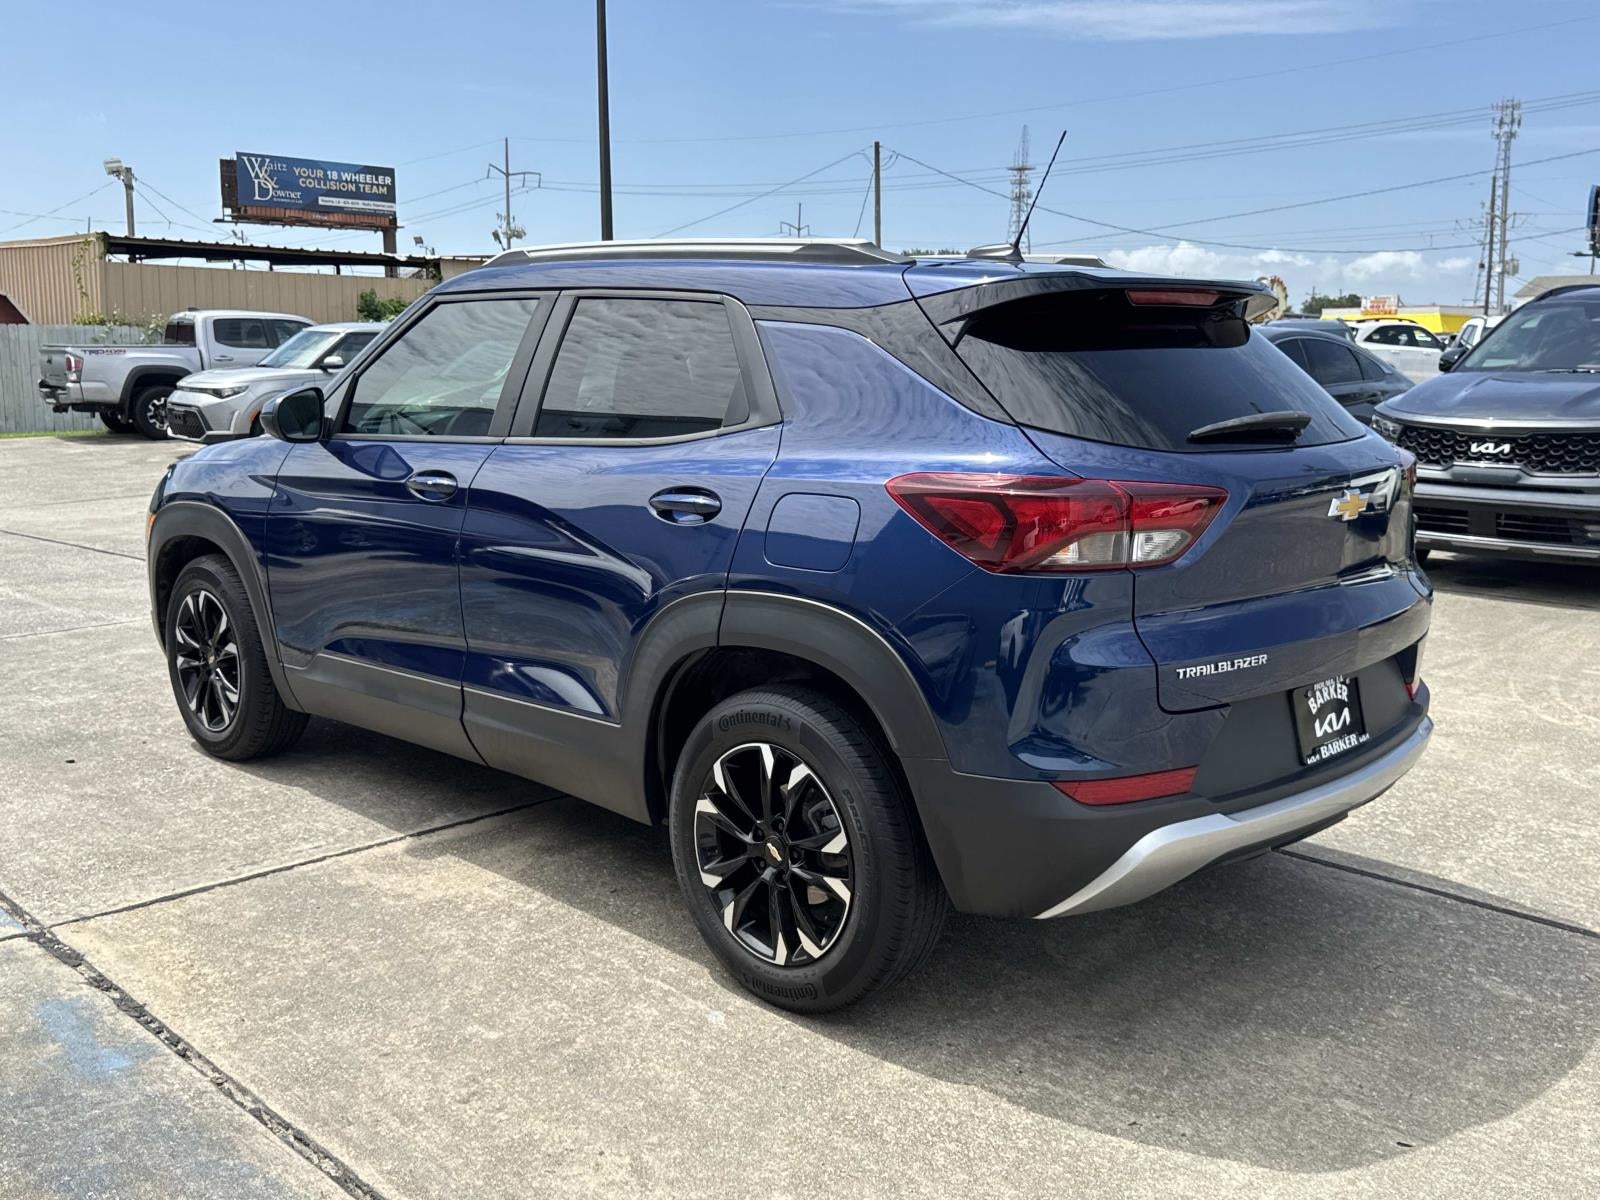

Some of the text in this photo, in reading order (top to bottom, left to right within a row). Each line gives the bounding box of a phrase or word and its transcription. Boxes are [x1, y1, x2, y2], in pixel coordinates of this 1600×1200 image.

[241, 156, 287, 179] Waitz
[260, 166, 279, 189] &
[293, 167, 392, 185] YOUR 18 WHEELER
[253, 178, 302, 201] Downer
[299, 178, 388, 195] COLLISION TEAM
[1176, 654, 1268, 680] TRAILBLAZER
[1308, 683, 1348, 715] BARKER
[719, 709, 783, 732] Continental
[1320, 733, 1358, 759] BARKER
